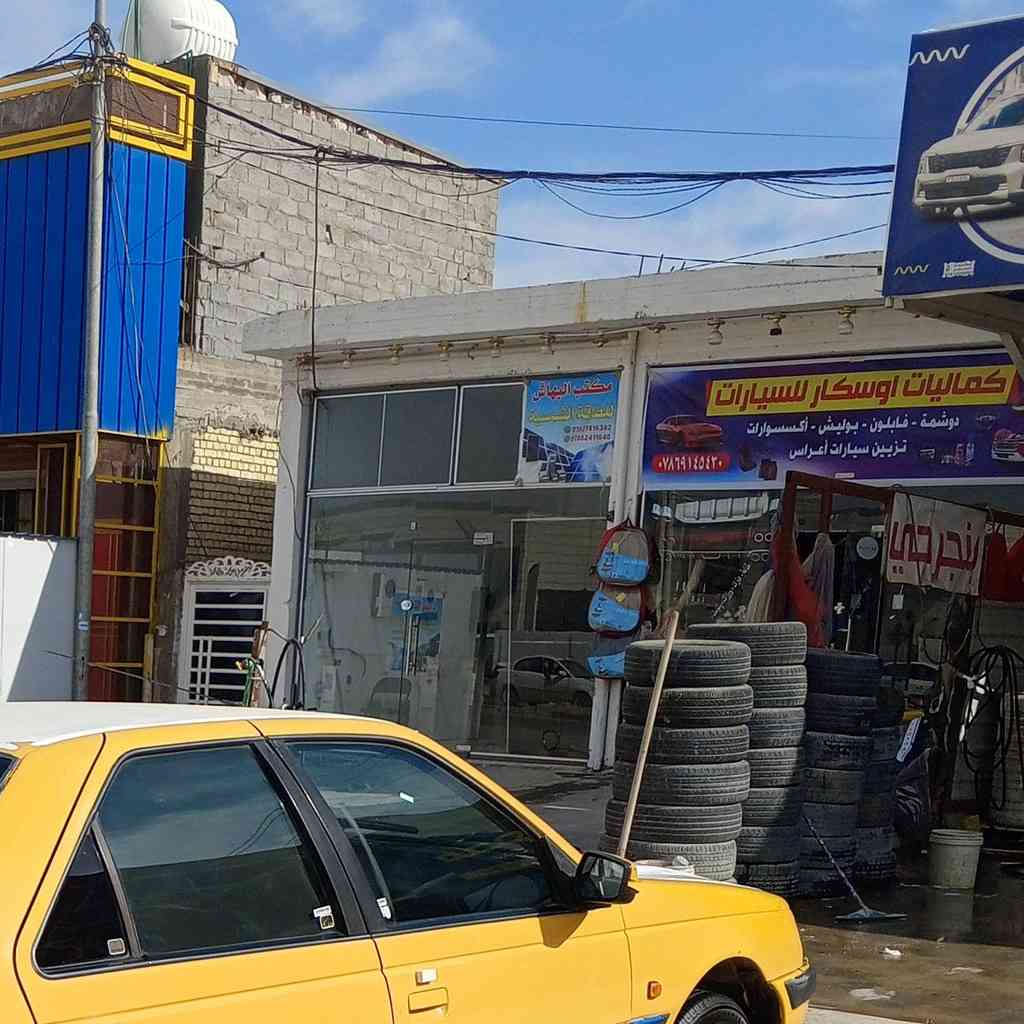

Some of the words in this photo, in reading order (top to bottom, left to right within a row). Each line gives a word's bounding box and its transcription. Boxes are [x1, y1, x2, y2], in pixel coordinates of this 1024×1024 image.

[810, 376, 899, 407] اوسكار
[903, 369, 1007, 401] كماليات
[715, 380, 807, 411] للسيارات
[747, 416, 808, 437] أكسسوارات
[818, 416, 859, 435] بوليش
[870, 414, 908, 433] فابلون
[920, 411, 960, 430] دوشمة
[789, 440, 828, 459] أعراس
[830, 442, 869, 458] سيارات
[872, 440, 907, 457] تزيين
